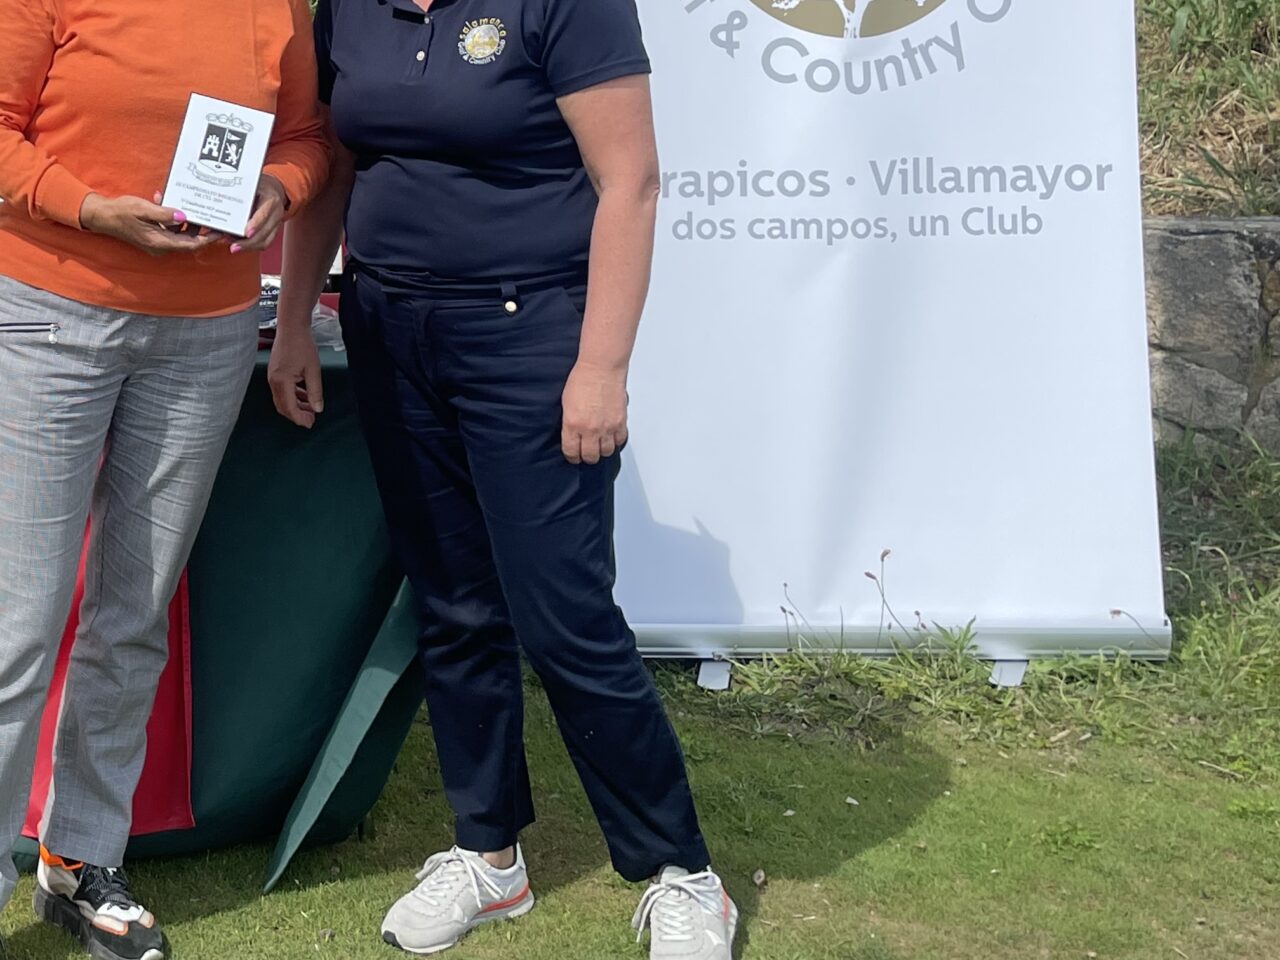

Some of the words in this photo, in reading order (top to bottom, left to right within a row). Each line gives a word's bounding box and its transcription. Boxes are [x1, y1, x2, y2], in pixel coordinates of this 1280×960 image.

[710, 10, 748, 59] &
[761, 21, 965, 95] Country
[662, 159, 830, 206] rapicos
[869, 157, 1112, 200] Villamayor
[672, 210, 736, 241] dos
[748, 216, 898, 246] campos,
[909, 214, 949, 238] un
[961, 205, 1042, 237] Club
